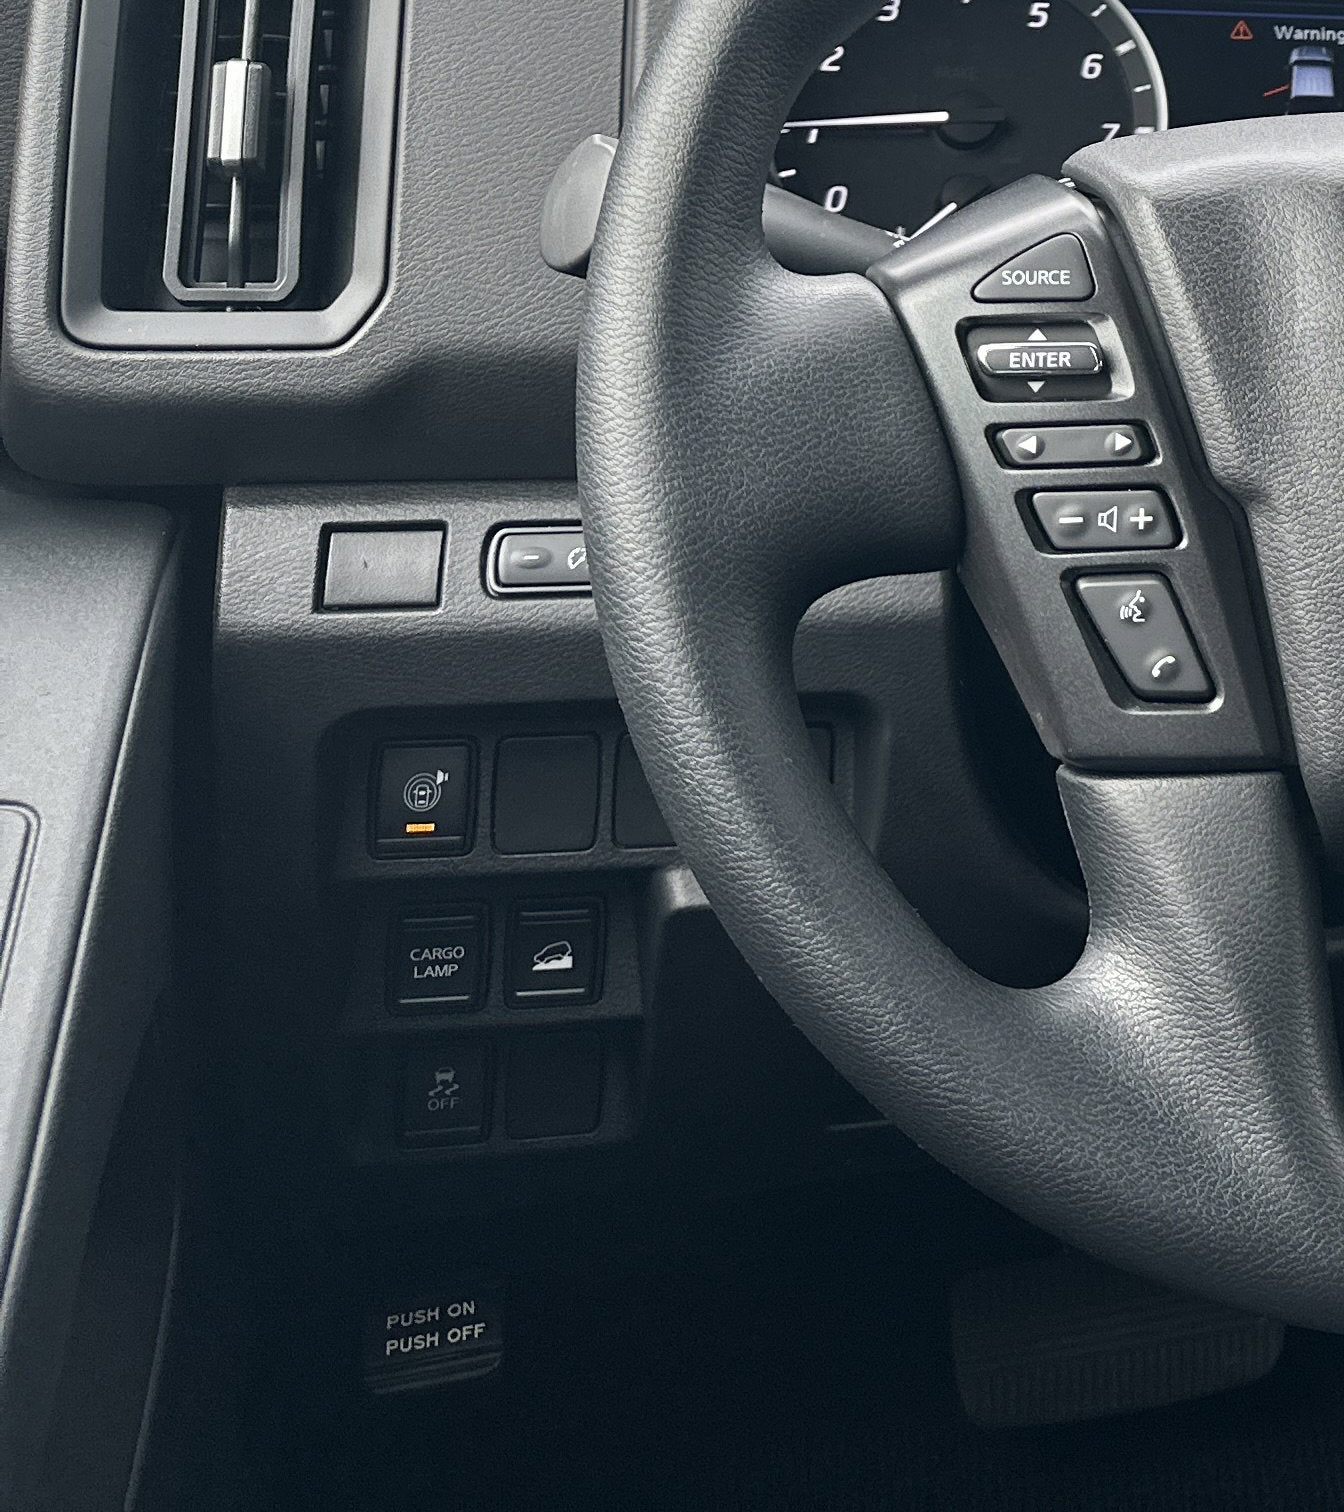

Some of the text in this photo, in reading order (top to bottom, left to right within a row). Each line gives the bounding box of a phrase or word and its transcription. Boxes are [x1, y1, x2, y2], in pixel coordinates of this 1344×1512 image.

[1026, 2, 1051, 29] 5
[819, 45, 845, 72] 2
[1080, 52, 1103, 79] 6
[824, 185, 848, 213] 0
[1001, 269, 1071, 286] SOURCE
[1008, 351, 1072, 369] ENTER
[410, 945, 465, 963] CARGO
[413, 962, 459, 979] LAMP
[426, 1096, 460, 1113] OFF
[386, 1299, 476, 1330] PUSH ON
[385, 1322, 487, 1357] PUSH OFF
